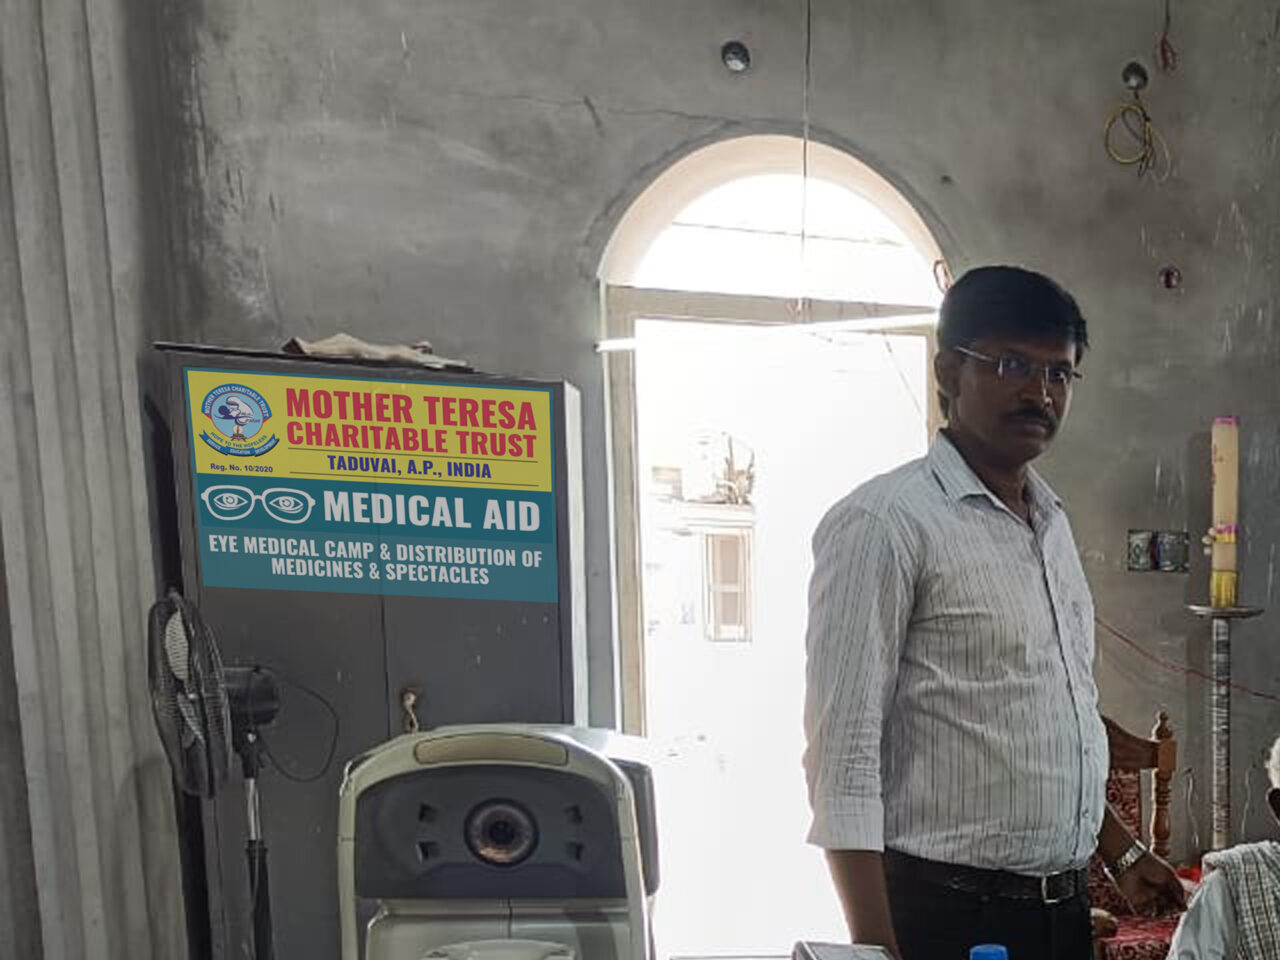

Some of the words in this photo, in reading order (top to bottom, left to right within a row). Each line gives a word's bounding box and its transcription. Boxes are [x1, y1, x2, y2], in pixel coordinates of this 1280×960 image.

[286, 388, 413, 424] MOTHER
[423, 396, 537, 431] TERESA
[287, 421, 448, 453] CHARITABLE
[456, 430, 537, 458] TRUST
[210, 463, 227, 472] Reg.
[327, 455, 402, 475] TADUVAI,
[407, 460, 443, 477] A.P.,
[447, 461, 492, 479] INDIA
[323, 490, 472, 528] MEDICAL
[483, 499, 541, 532] AID
[208, 534, 237, 553] EYE
[243, 536, 319, 557] MEDICAL
[325, 540, 374, 559] CAMP
[379, 542, 391, 560] &
[396, 544, 516, 567] DISTRIBUTION
[522, 550, 542, 568] OF
[271, 558, 363, 579] MEDICINES
[369, 563, 380, 580] &
[385, 564, 490, 585] SPECTACLES
